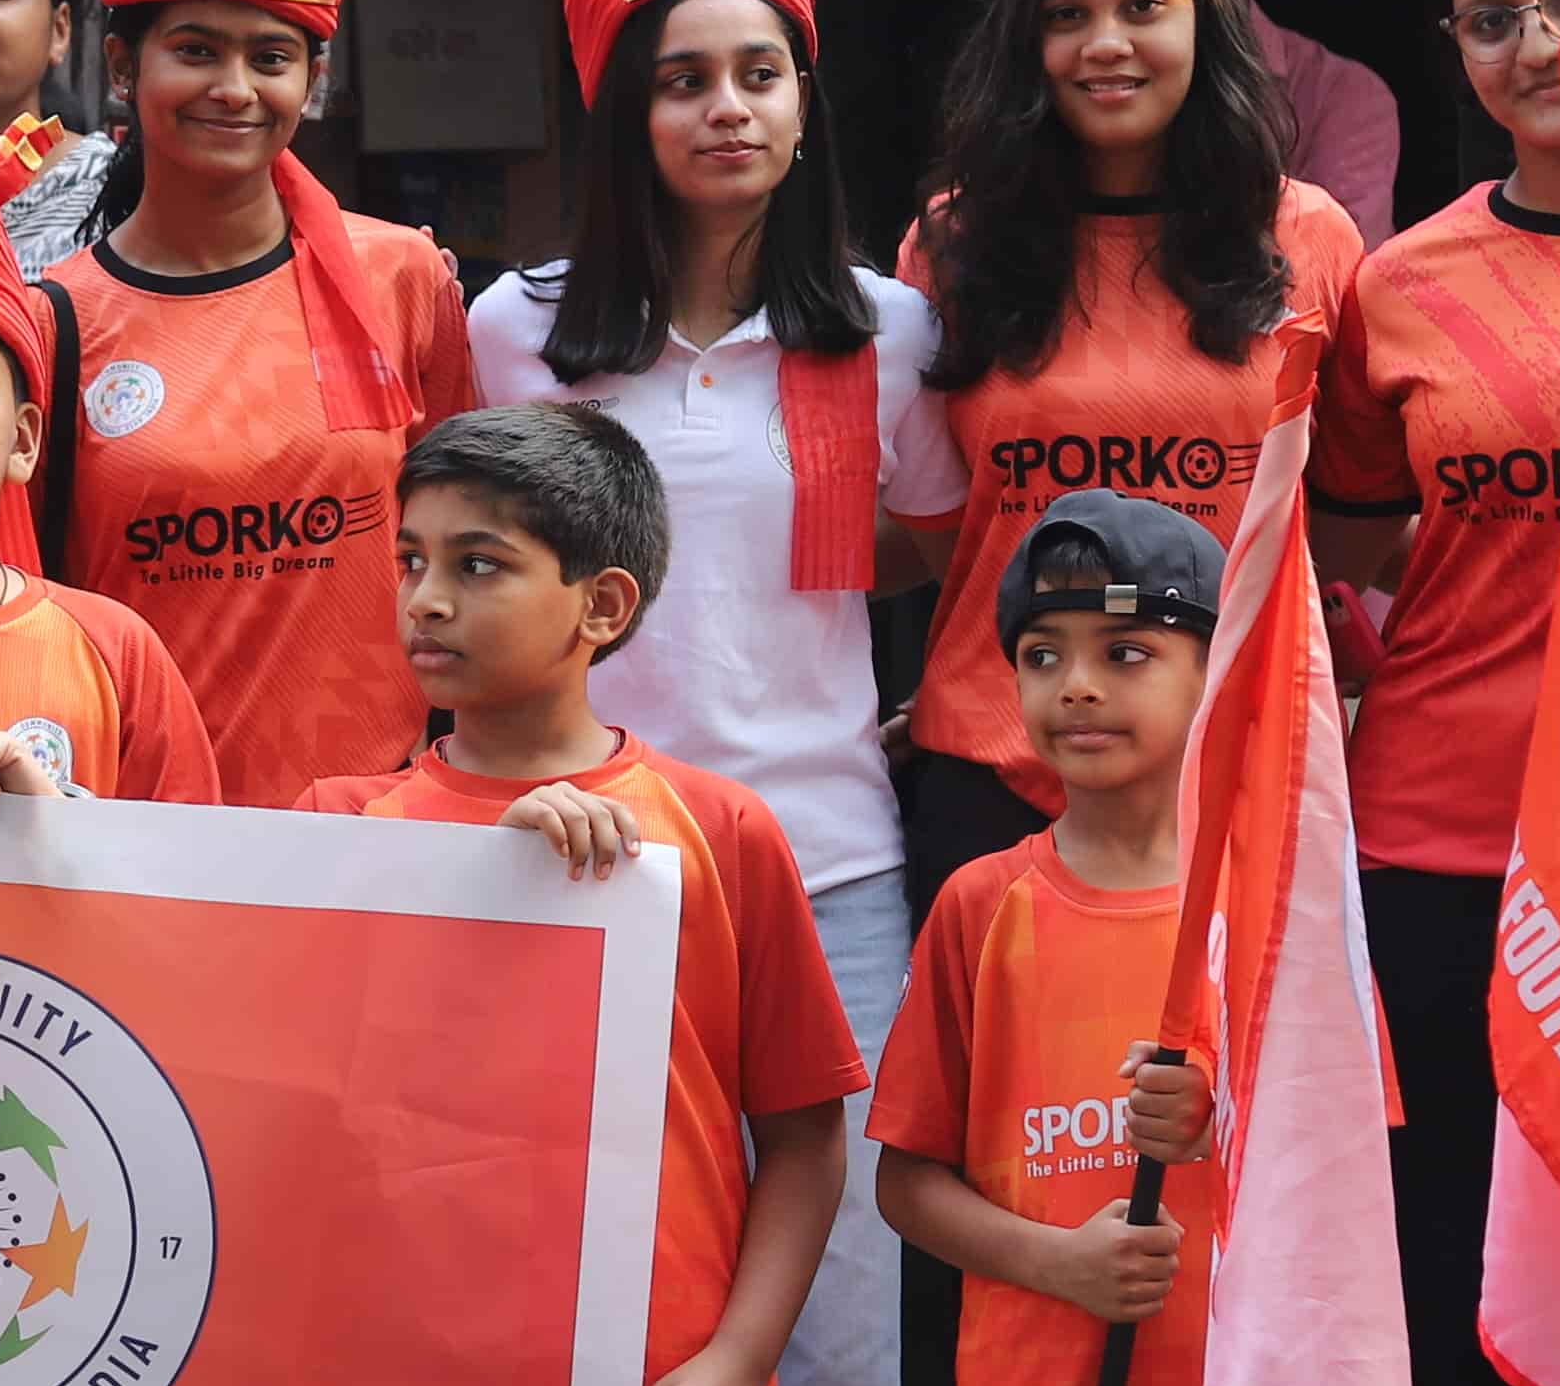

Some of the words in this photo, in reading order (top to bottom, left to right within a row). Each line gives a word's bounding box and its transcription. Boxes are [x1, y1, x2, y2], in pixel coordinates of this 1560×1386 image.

[124, 495, 346, 563] SPORKO
[169, 564, 225, 582] Little
[233, 562, 265, 583] Big
[272, 555, 336, 576] Dream
[1023, 1096, 1132, 1158] SPOR
[1058, 1153, 1106, 1175] Little
[160, 1236, 183, 1260] 17
